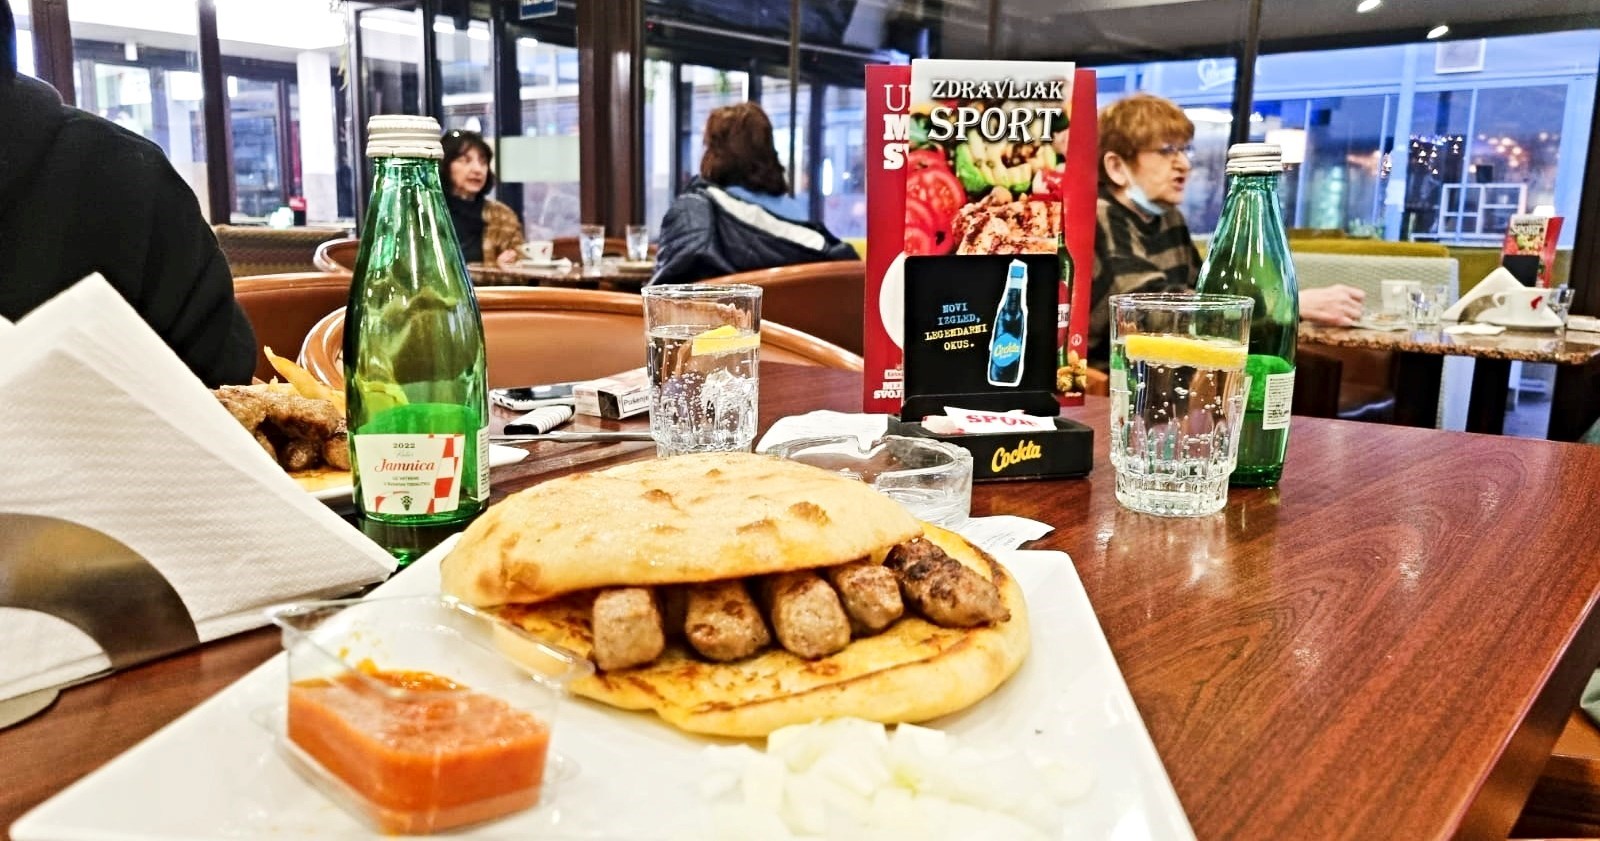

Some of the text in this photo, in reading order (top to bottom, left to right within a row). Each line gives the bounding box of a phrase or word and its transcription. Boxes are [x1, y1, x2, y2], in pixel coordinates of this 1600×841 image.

[883, 84, 911, 112] U
[931, 78, 1064, 101] ZDRAVLJAK
[928, 106, 1061, 142] SPORT
[942, 302, 969, 314] NOVI
[936, 313, 981, 326] IZGLED,
[924, 323, 988, 341] LEGENDARNI
[943, 339, 975, 351] OKUS.
[991, 439, 1042, 473] Cockta
[374, 458, 436, 473] Jamnica
